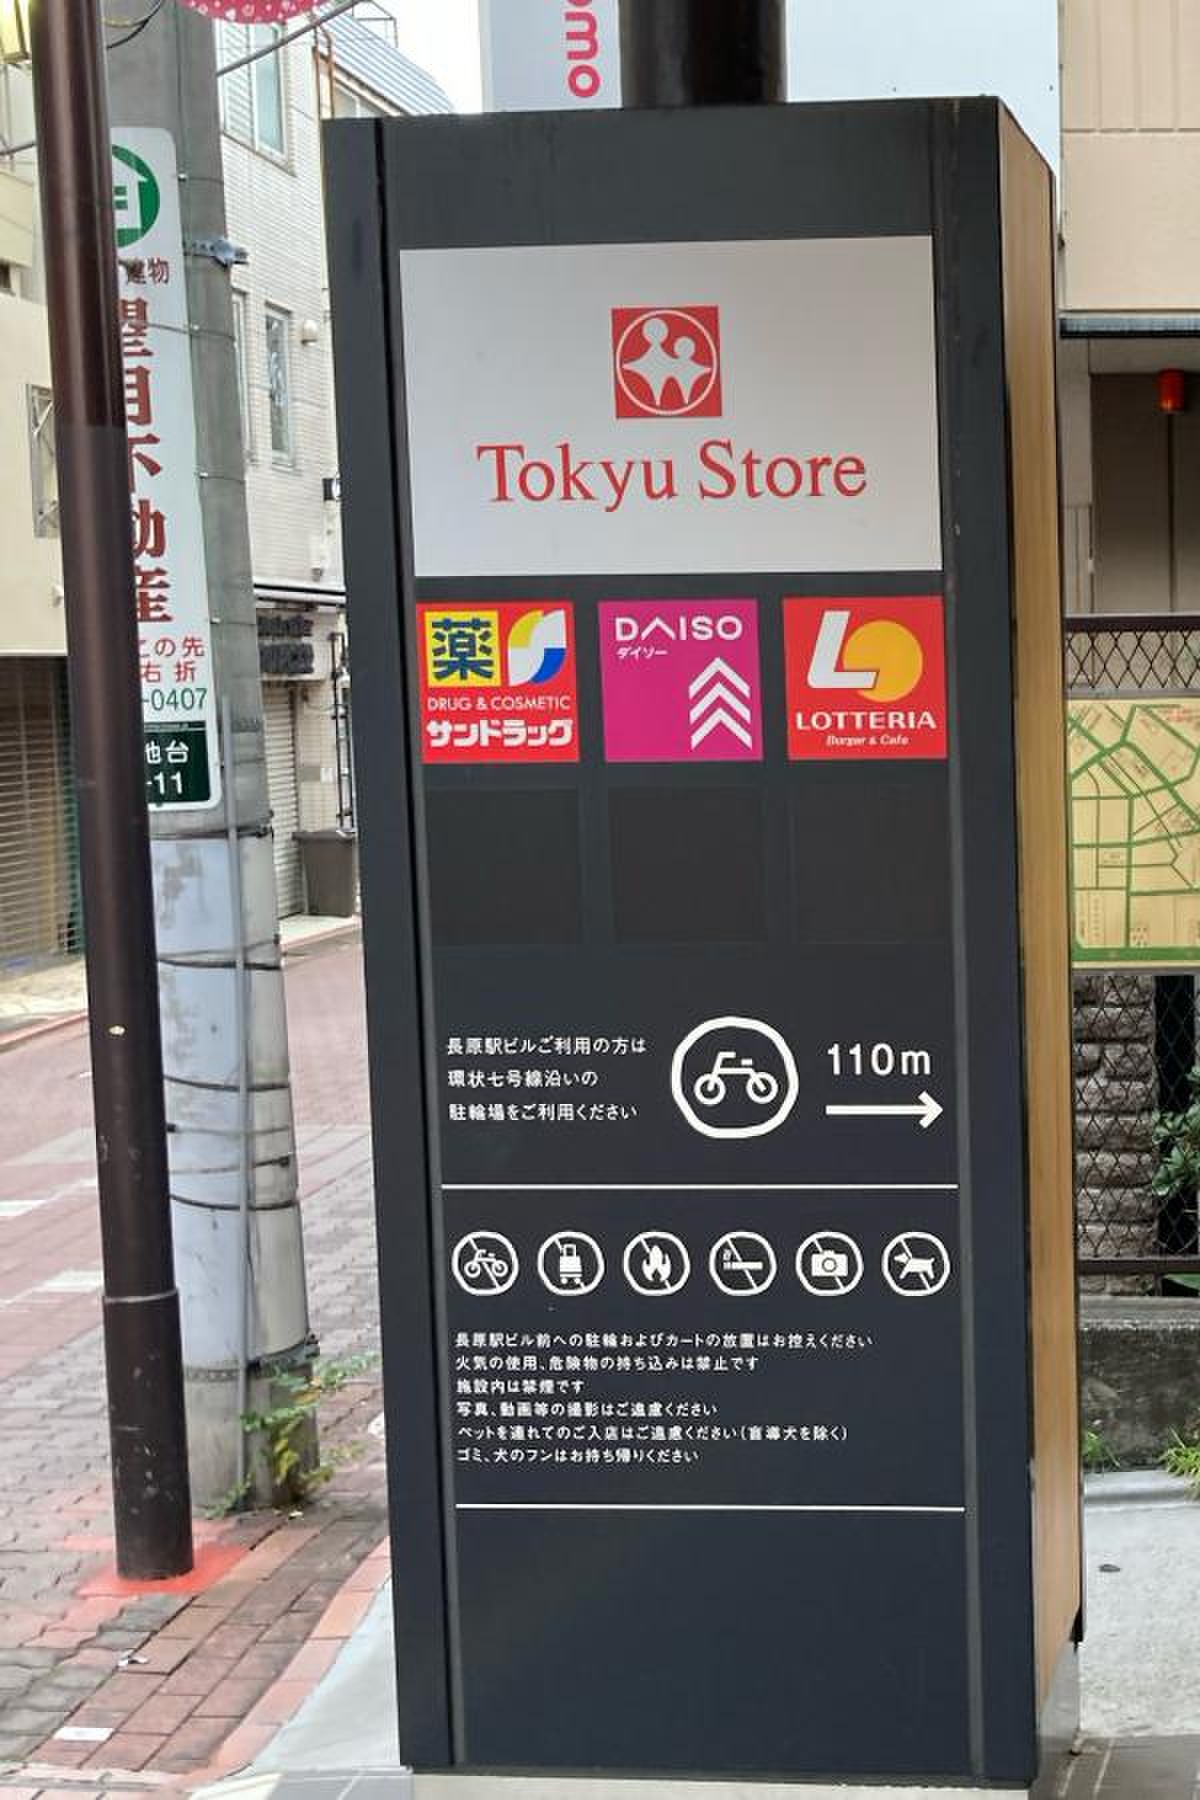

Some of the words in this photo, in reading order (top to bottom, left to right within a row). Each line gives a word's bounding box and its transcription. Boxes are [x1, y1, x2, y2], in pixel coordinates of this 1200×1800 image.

[565, 0, 602, 97] mo
[476, 442, 676, 513] Tokyu
[698, 439, 867, 499] Store
[615, 615, 744, 641] DAISO
[432, 617, 493, 681] 薬
[617, 646, 668, 660] ダイソー
[427, 697, 472, 710] DRUG
[491, 695, 571, 710] COSMETIC
[796, 711, 938, 731] LOTTERIA
[426, 719, 574, 747] サンドラッグ
[447, 1036, 647, 1056] 長原駅ビルご利用の方は
[447, 1069, 599, 1088] 環状七号線沿いの
[448, 1103, 639, 1121] 駐輪場をご利用ください
[456, 1378, 585, 1395] 施設内は禁煙です
